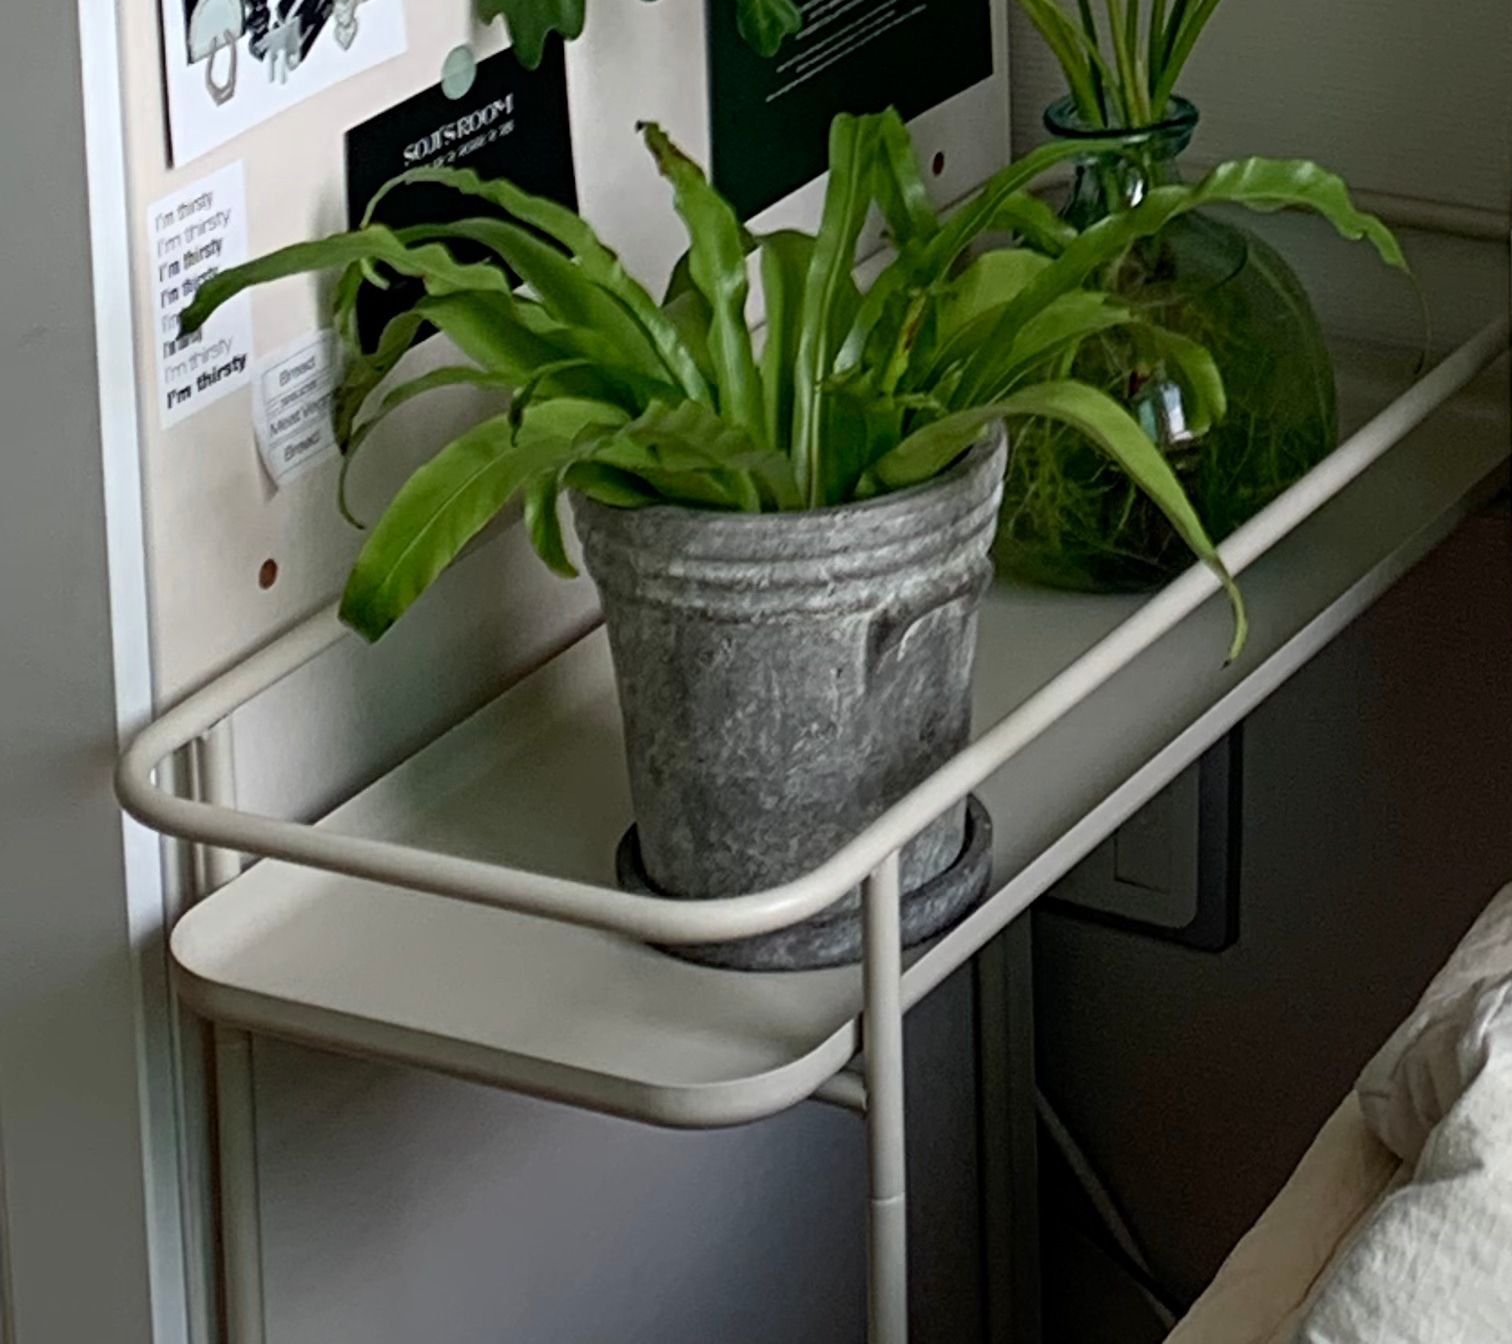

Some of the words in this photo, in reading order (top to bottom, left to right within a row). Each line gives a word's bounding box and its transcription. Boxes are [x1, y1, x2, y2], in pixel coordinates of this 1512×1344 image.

[457, 92, 515, 139] ROOM
[183, 236, 223, 271] thirsty
[166, 386, 192, 410] I'm
[196, 352, 248, 393] thirsty
